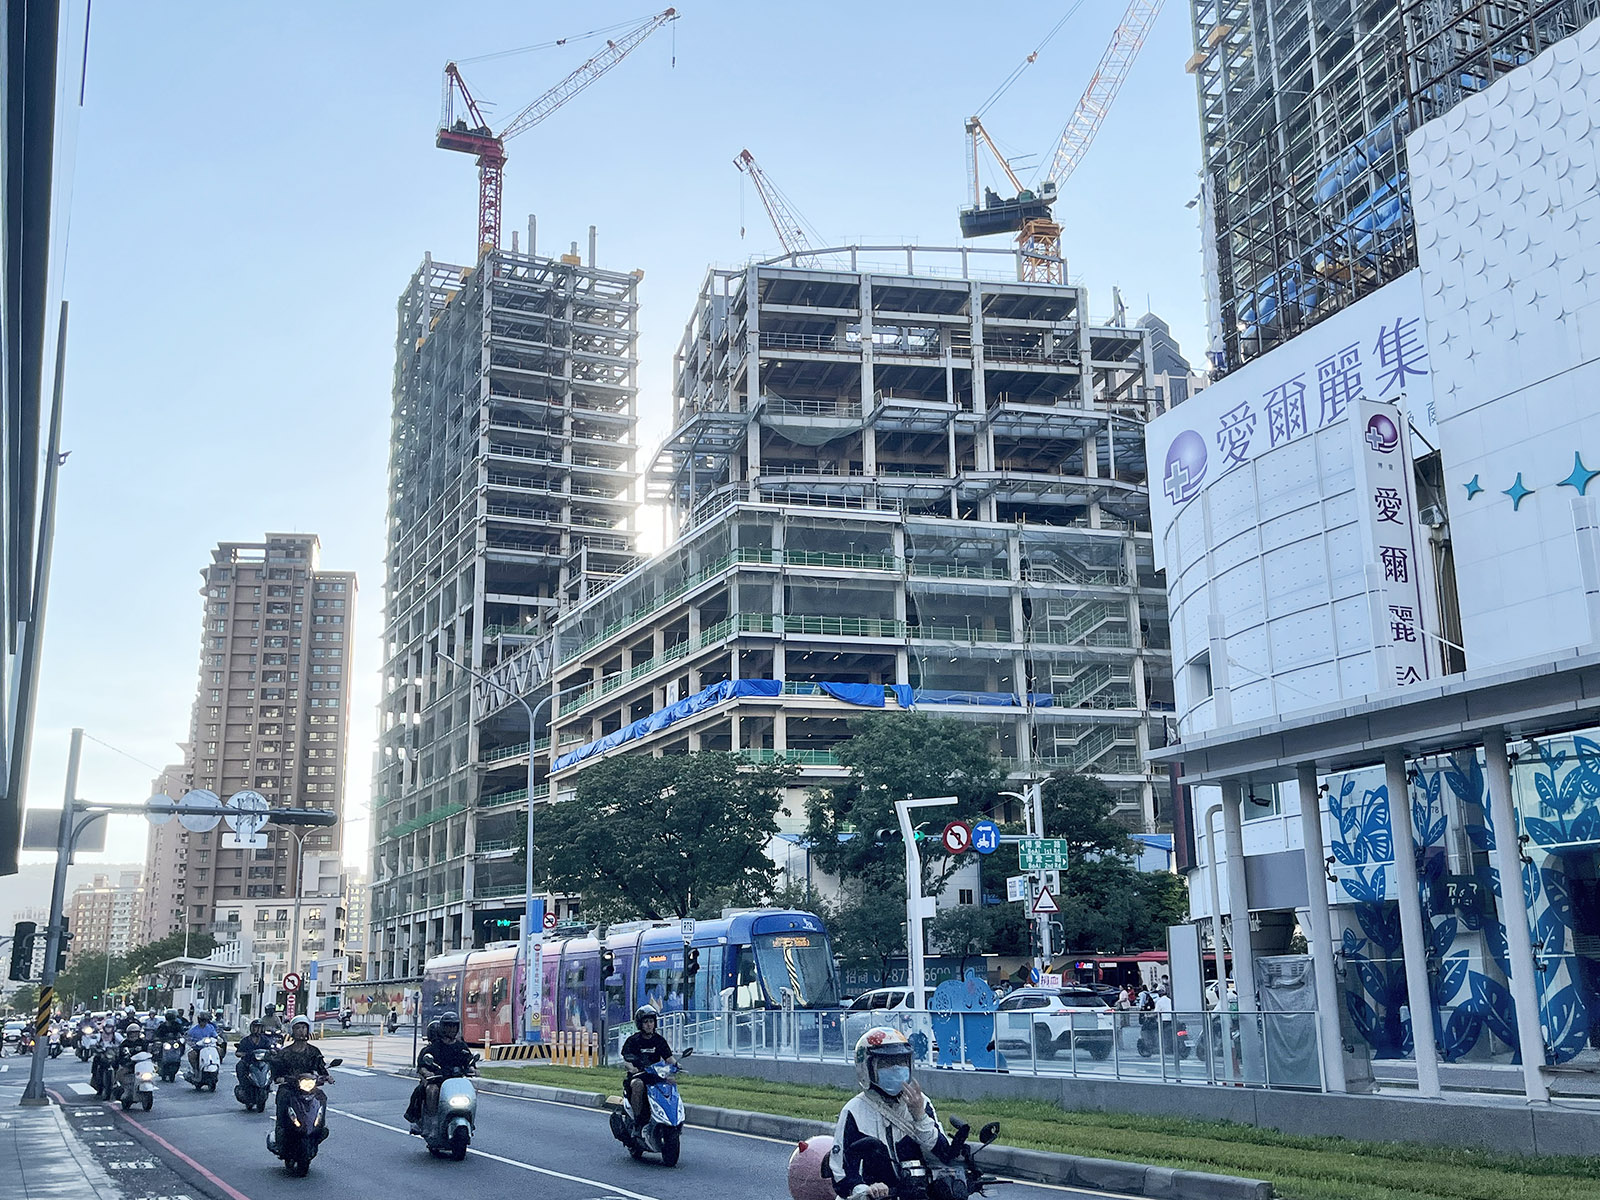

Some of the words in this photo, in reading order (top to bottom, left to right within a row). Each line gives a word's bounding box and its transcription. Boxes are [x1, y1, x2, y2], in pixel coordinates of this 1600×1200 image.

[1216, 316, 1429, 476] 愛爾麗集
[1025, 840, 1061, 849] 博愛一路
[1026, 855, 1062, 863] 博愛二路
